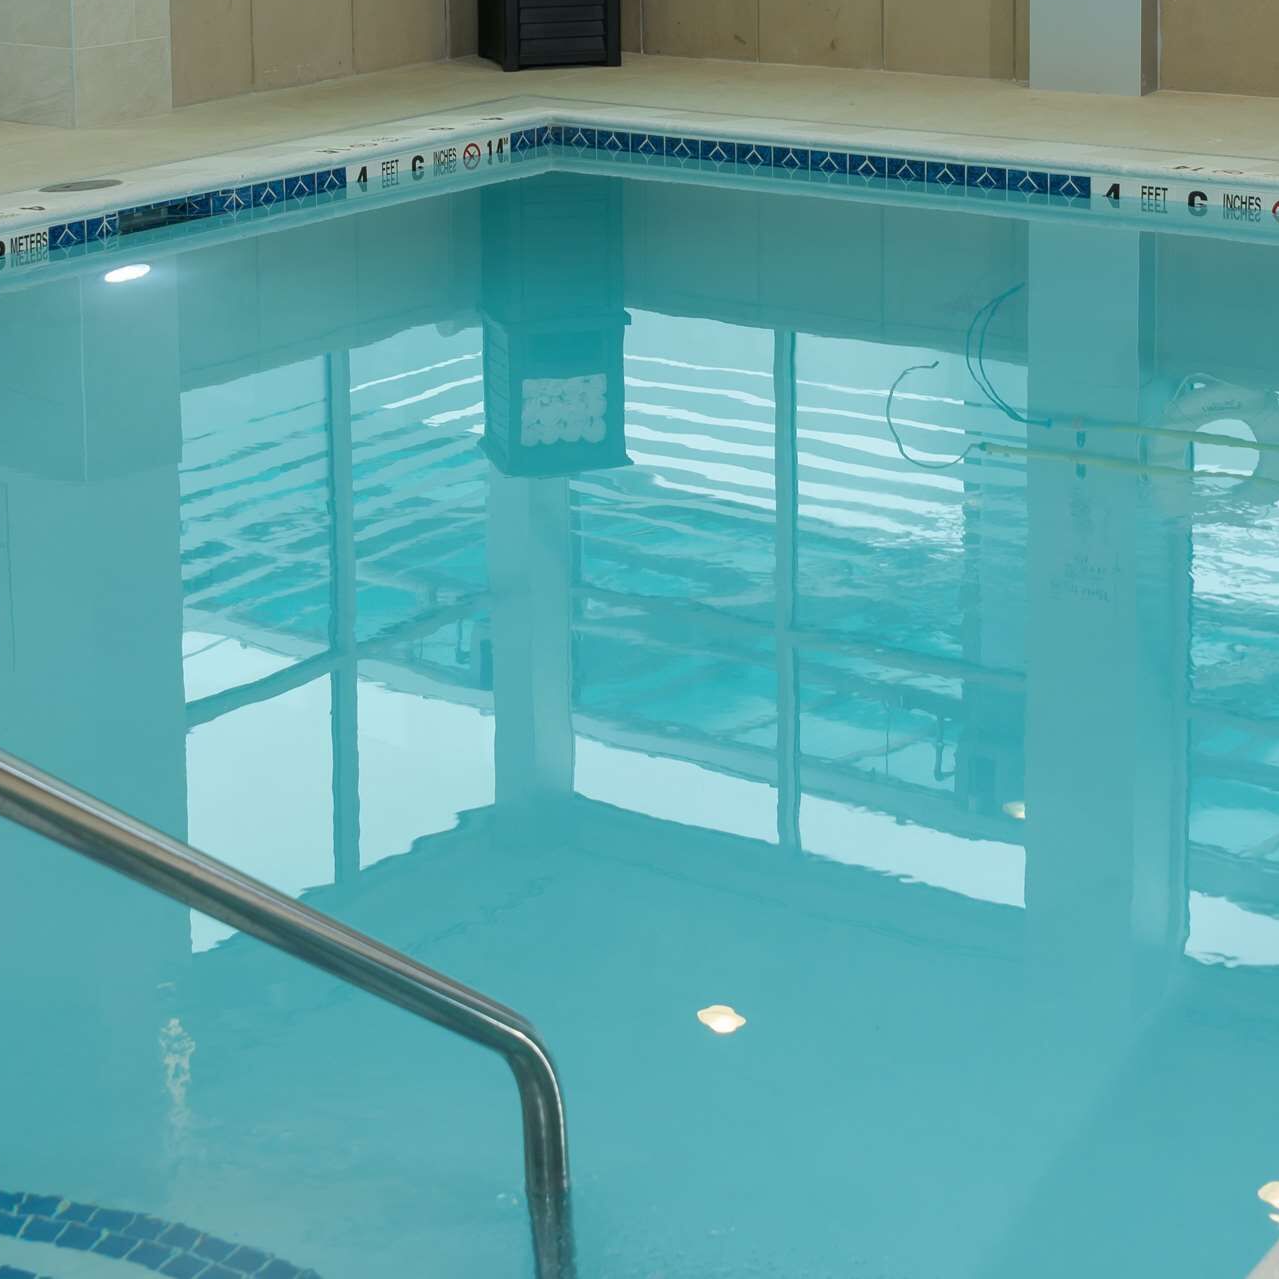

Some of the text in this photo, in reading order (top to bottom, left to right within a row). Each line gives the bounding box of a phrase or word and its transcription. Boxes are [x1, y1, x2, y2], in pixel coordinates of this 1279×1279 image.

[381, 159, 400, 177] FEET
[433, 147, 457, 167] INCHES
[1141, 185, 1168, 201] FEET
[1223, 193, 1262, 212] INCHES
[10, 231, 48, 257] METERS
